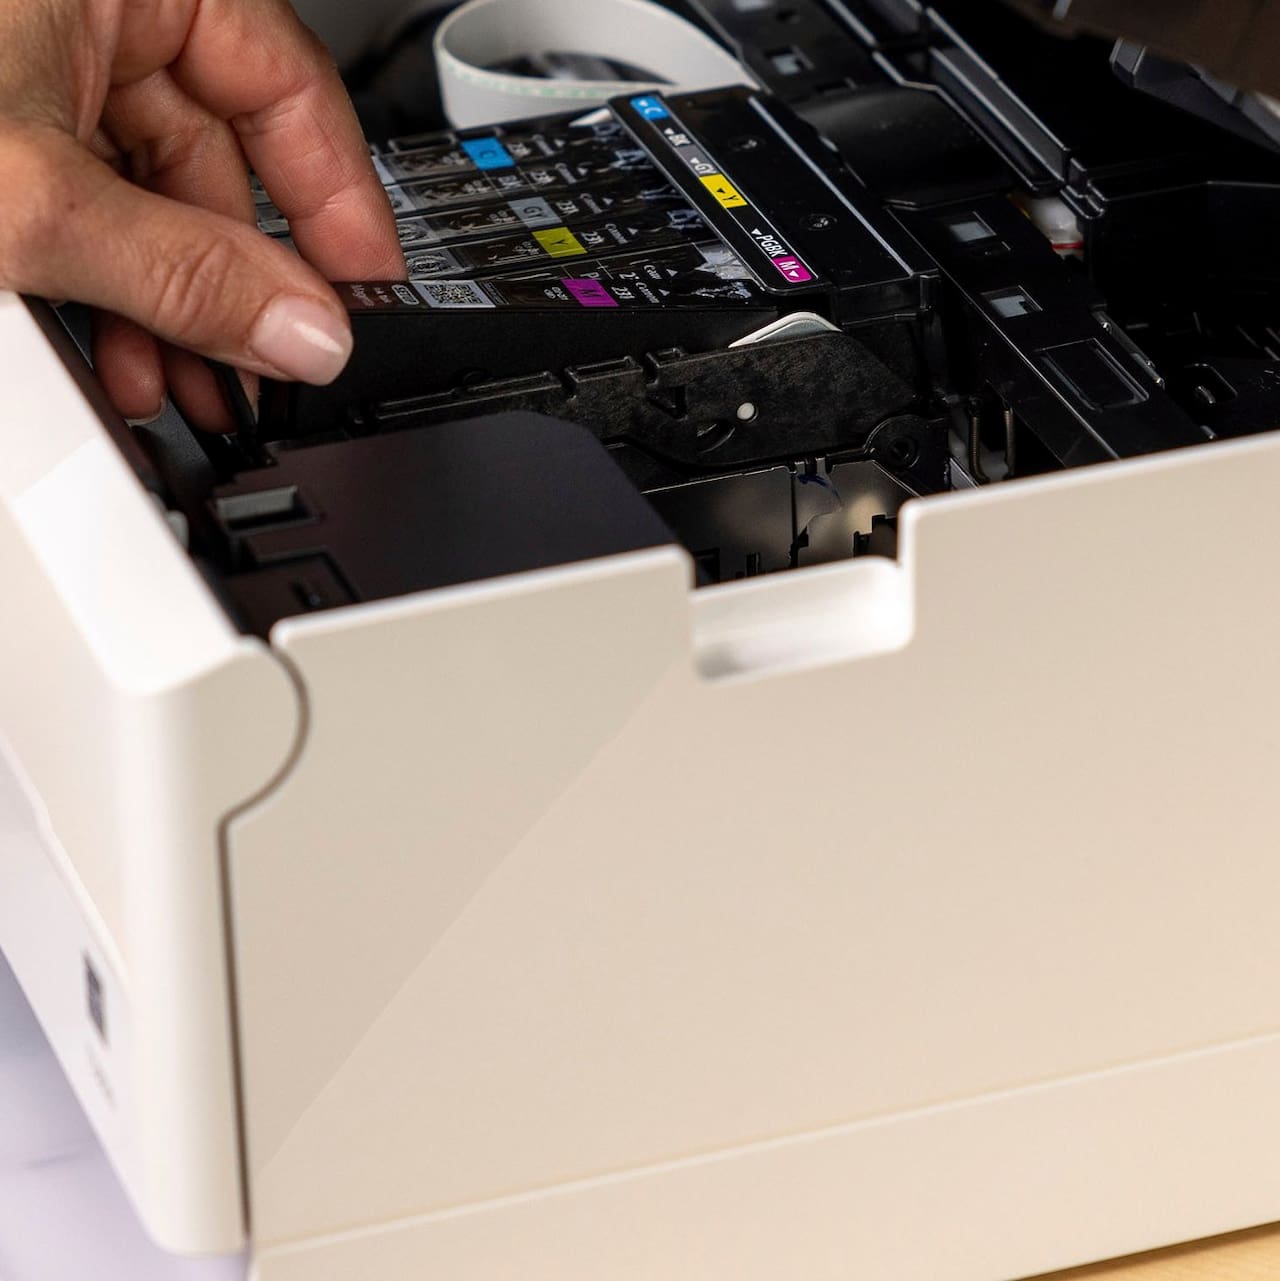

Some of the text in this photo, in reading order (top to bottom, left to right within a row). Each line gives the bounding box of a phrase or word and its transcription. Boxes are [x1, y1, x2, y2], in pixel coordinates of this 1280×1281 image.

[644, 107, 663, 115] C
[694, 163, 717, 175] GY
[604, 223, 628, 245] Canon
[756, 234, 788, 257] PGBK
[778, 260, 800, 270] M
[577, 288, 603, 298] M
[611, 286, 635, 299] 231
[635, 281, 660, 304] Canon
